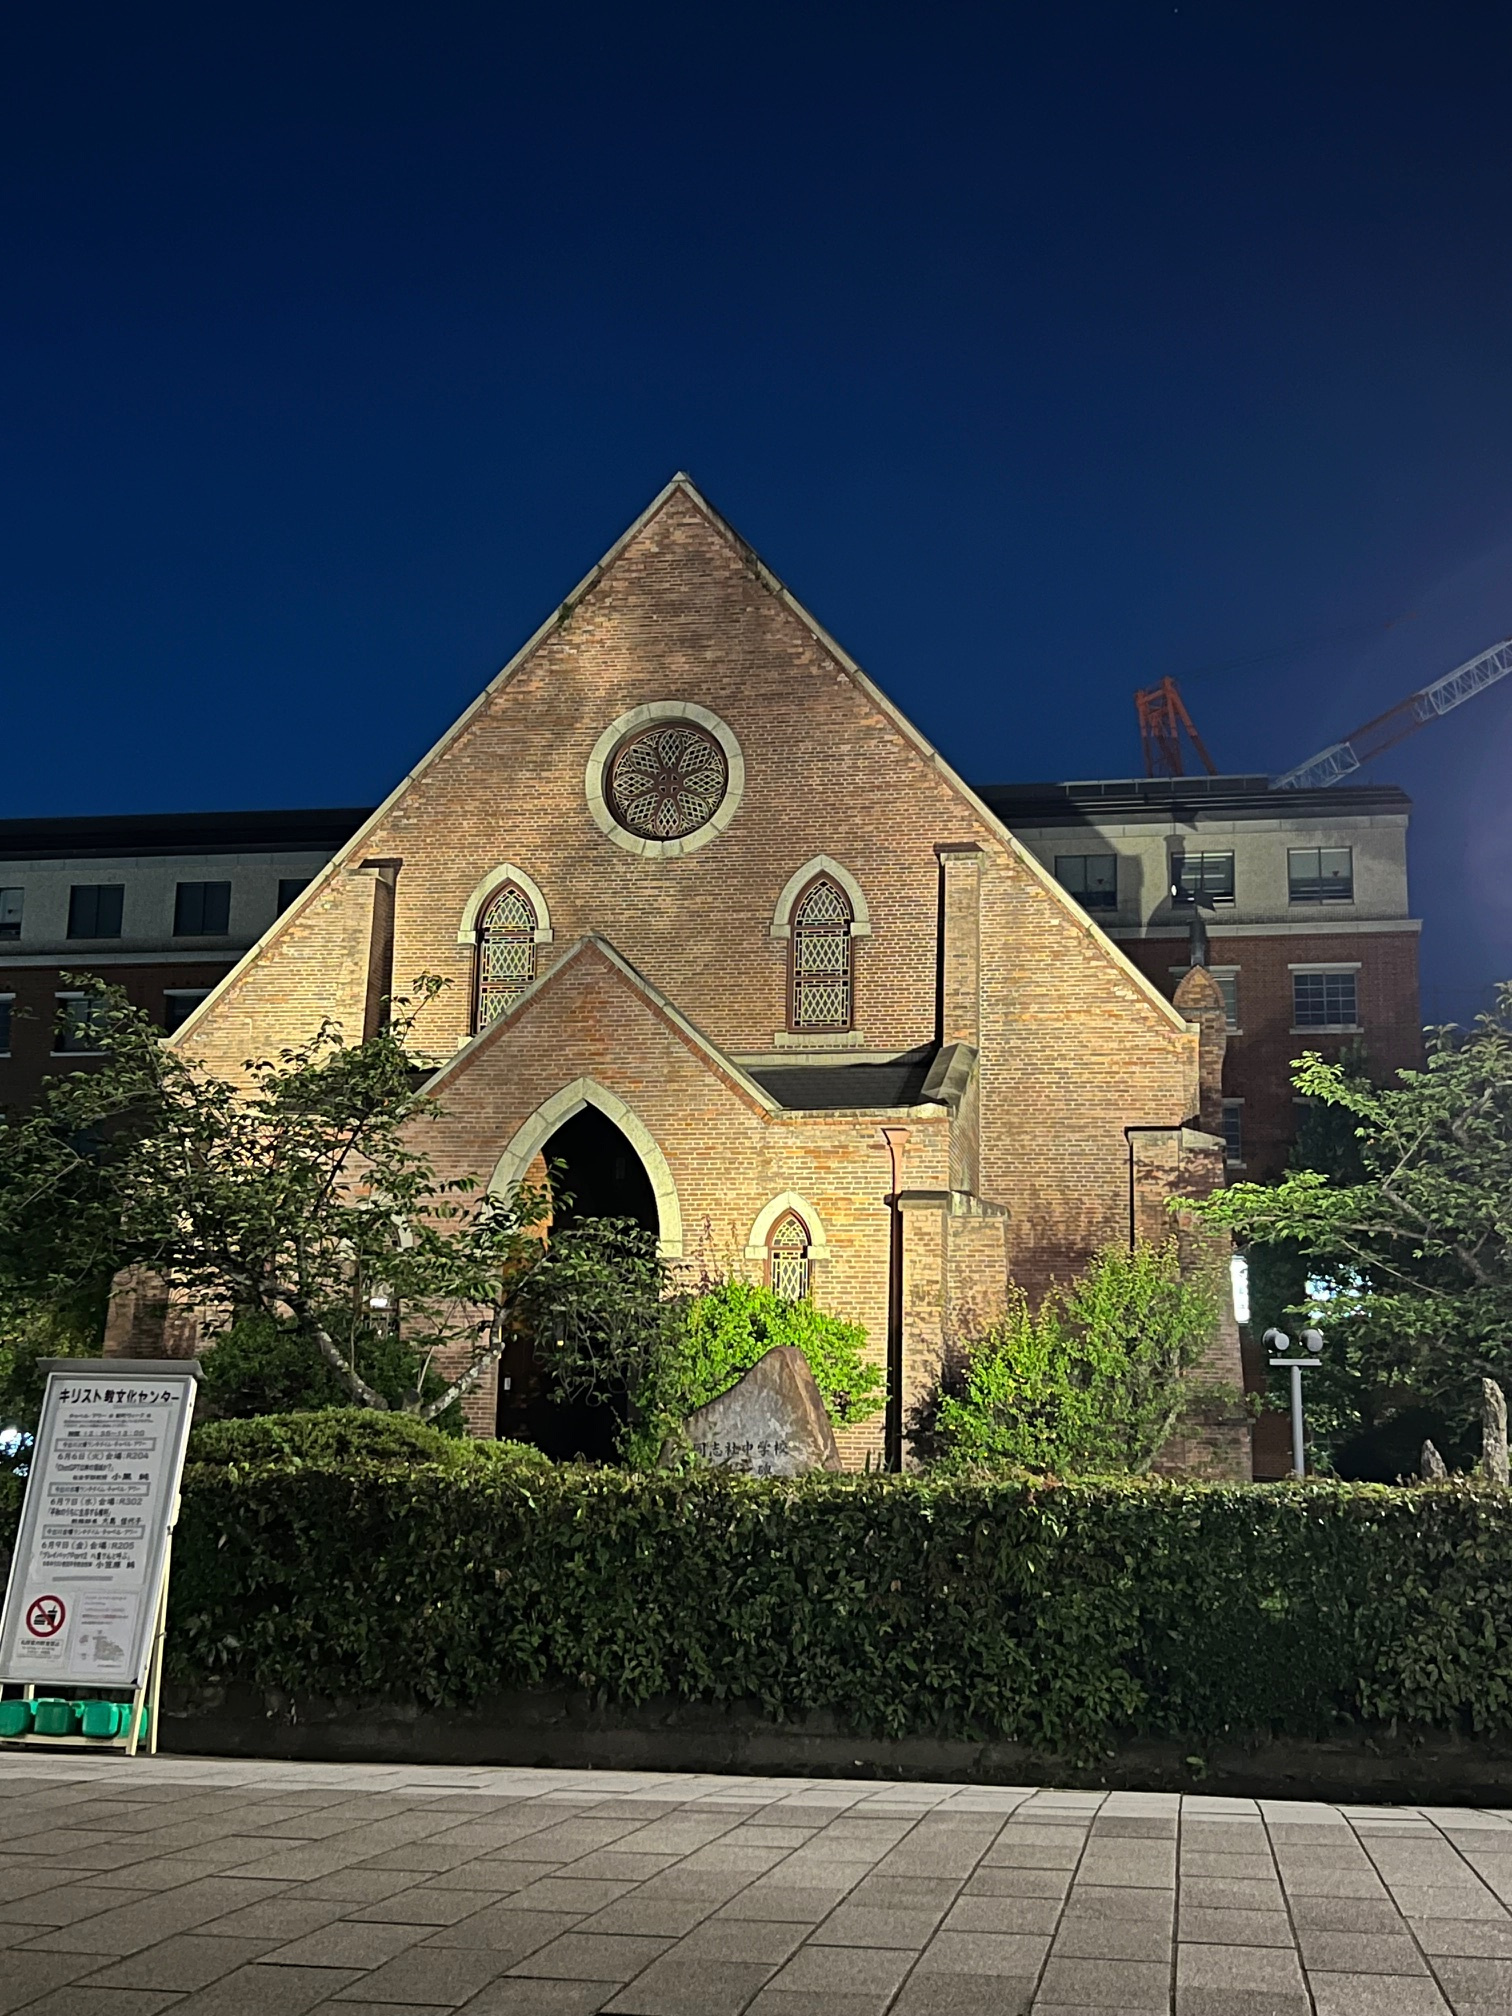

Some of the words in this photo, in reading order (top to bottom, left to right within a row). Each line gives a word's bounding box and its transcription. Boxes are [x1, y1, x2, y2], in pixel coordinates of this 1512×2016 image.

[59, 1388, 180, 1404] キリスト教文化センター
